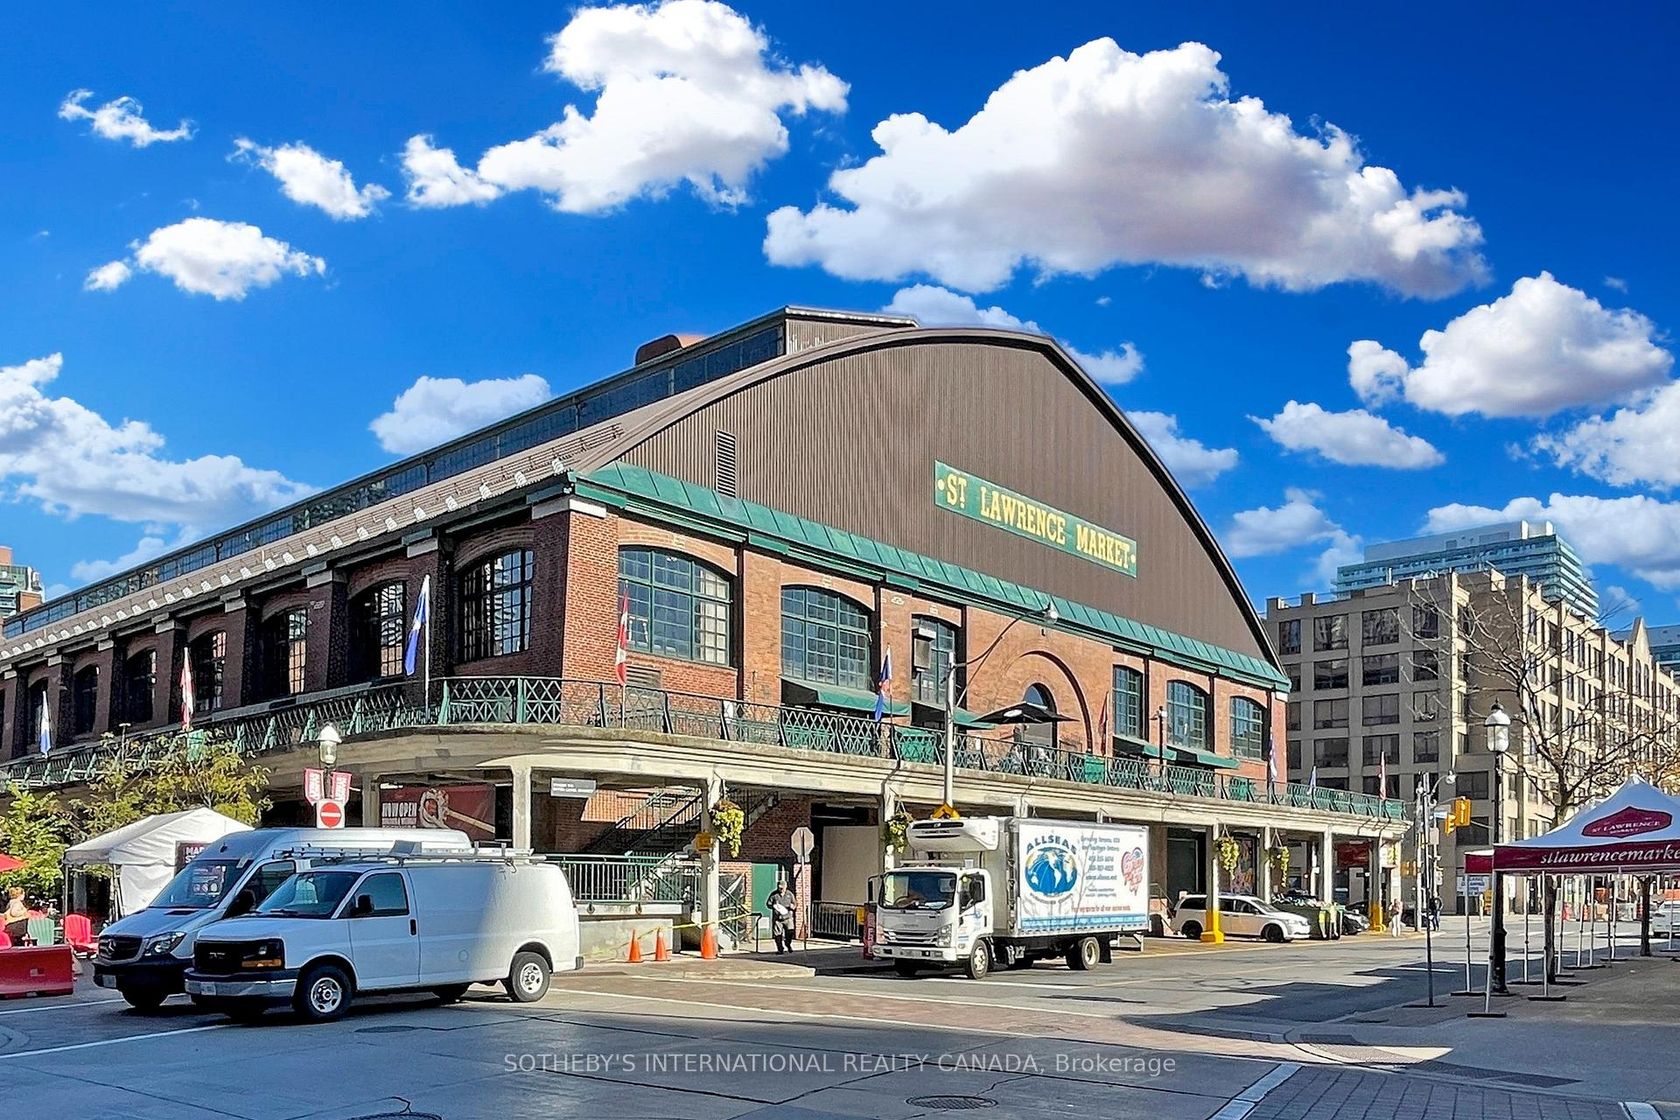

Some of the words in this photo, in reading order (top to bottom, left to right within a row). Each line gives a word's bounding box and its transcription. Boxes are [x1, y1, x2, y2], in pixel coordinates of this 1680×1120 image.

[979, 486, 1066, 545] LAWRENCE
[1076, 523, 1130, 569] MARKET
[382, 802, 398, 818] NOW
[399, 802, 417, 818] OPEN
[1603, 821, 1660, 832] LAWRENCE
[1026, 834, 1077, 855] ALLSEAS
